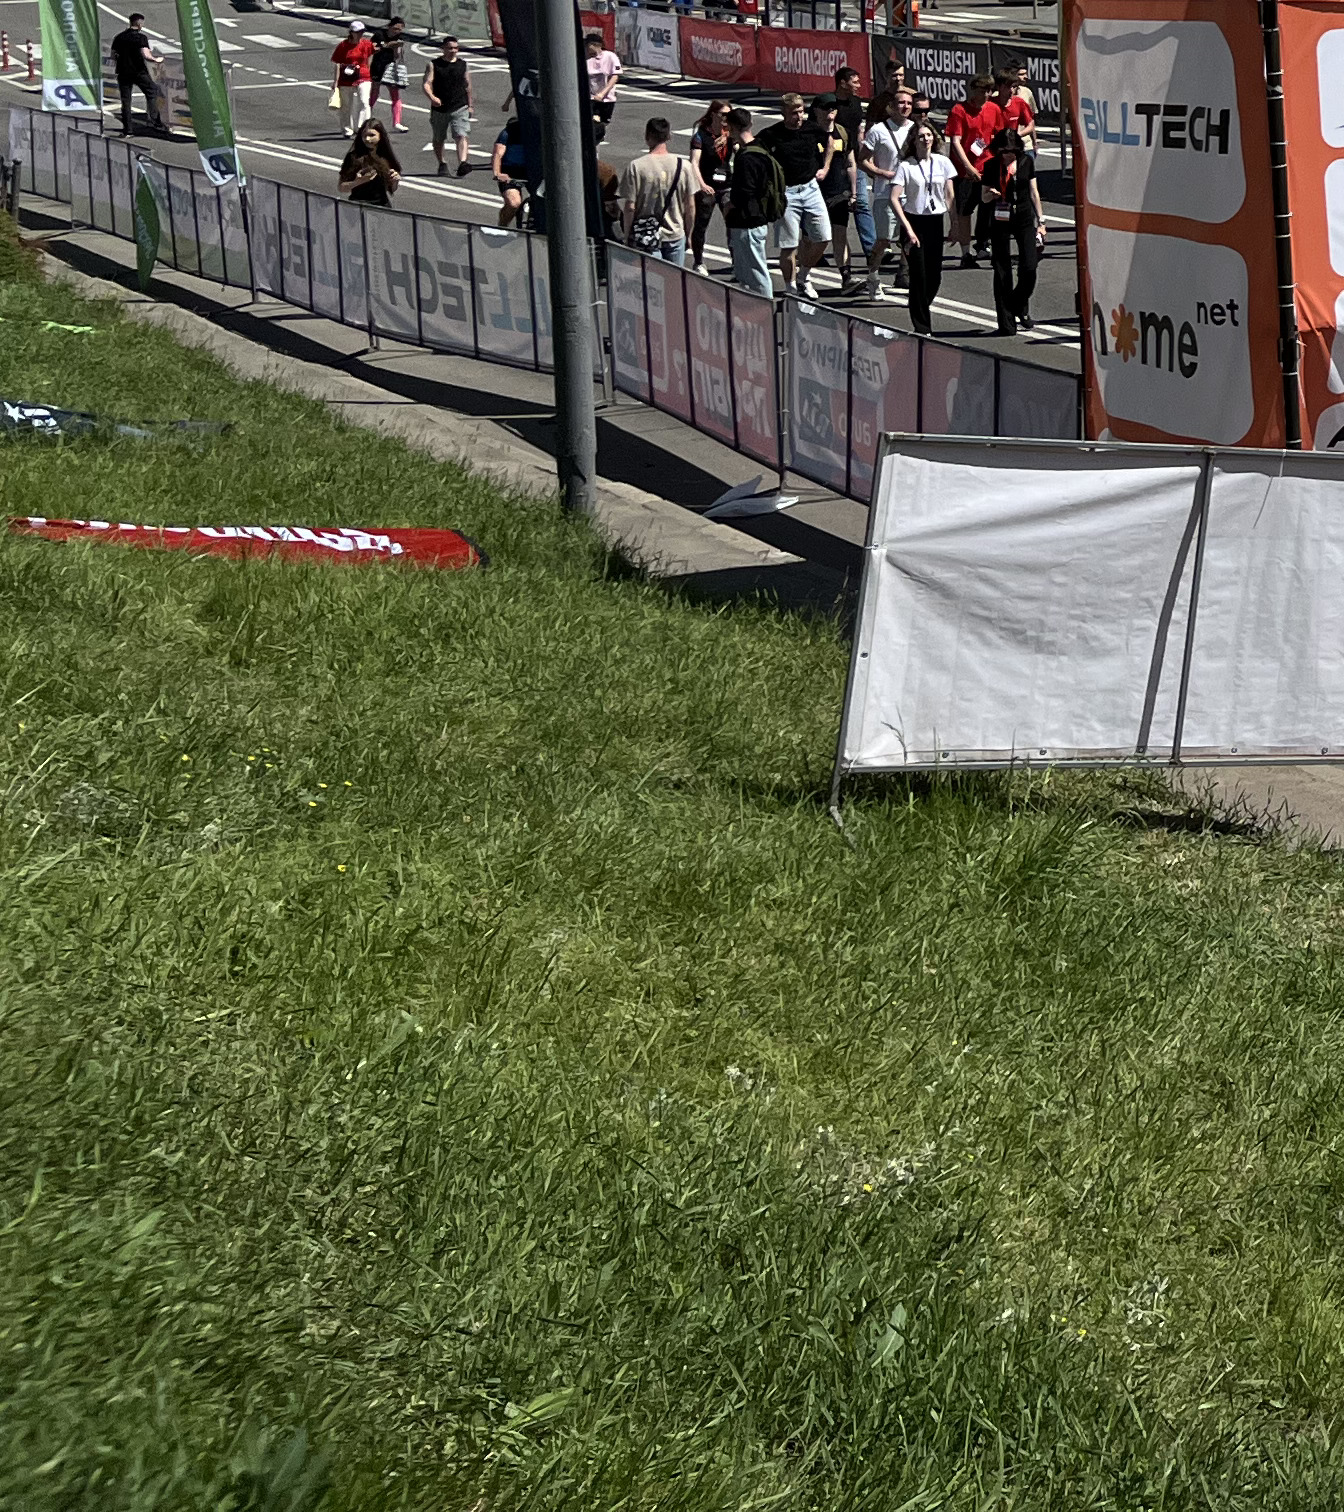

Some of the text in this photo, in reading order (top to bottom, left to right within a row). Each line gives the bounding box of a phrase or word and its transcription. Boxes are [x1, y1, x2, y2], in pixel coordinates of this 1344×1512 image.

[775, 46, 848, 77] велопланета
[905, 47, 976, 75] MITSUBISHI
[916, 76, 967, 101] MOTORS
[1081, 97, 1231, 155] BILLTECH
[1196, 298, 1239, 327] net
